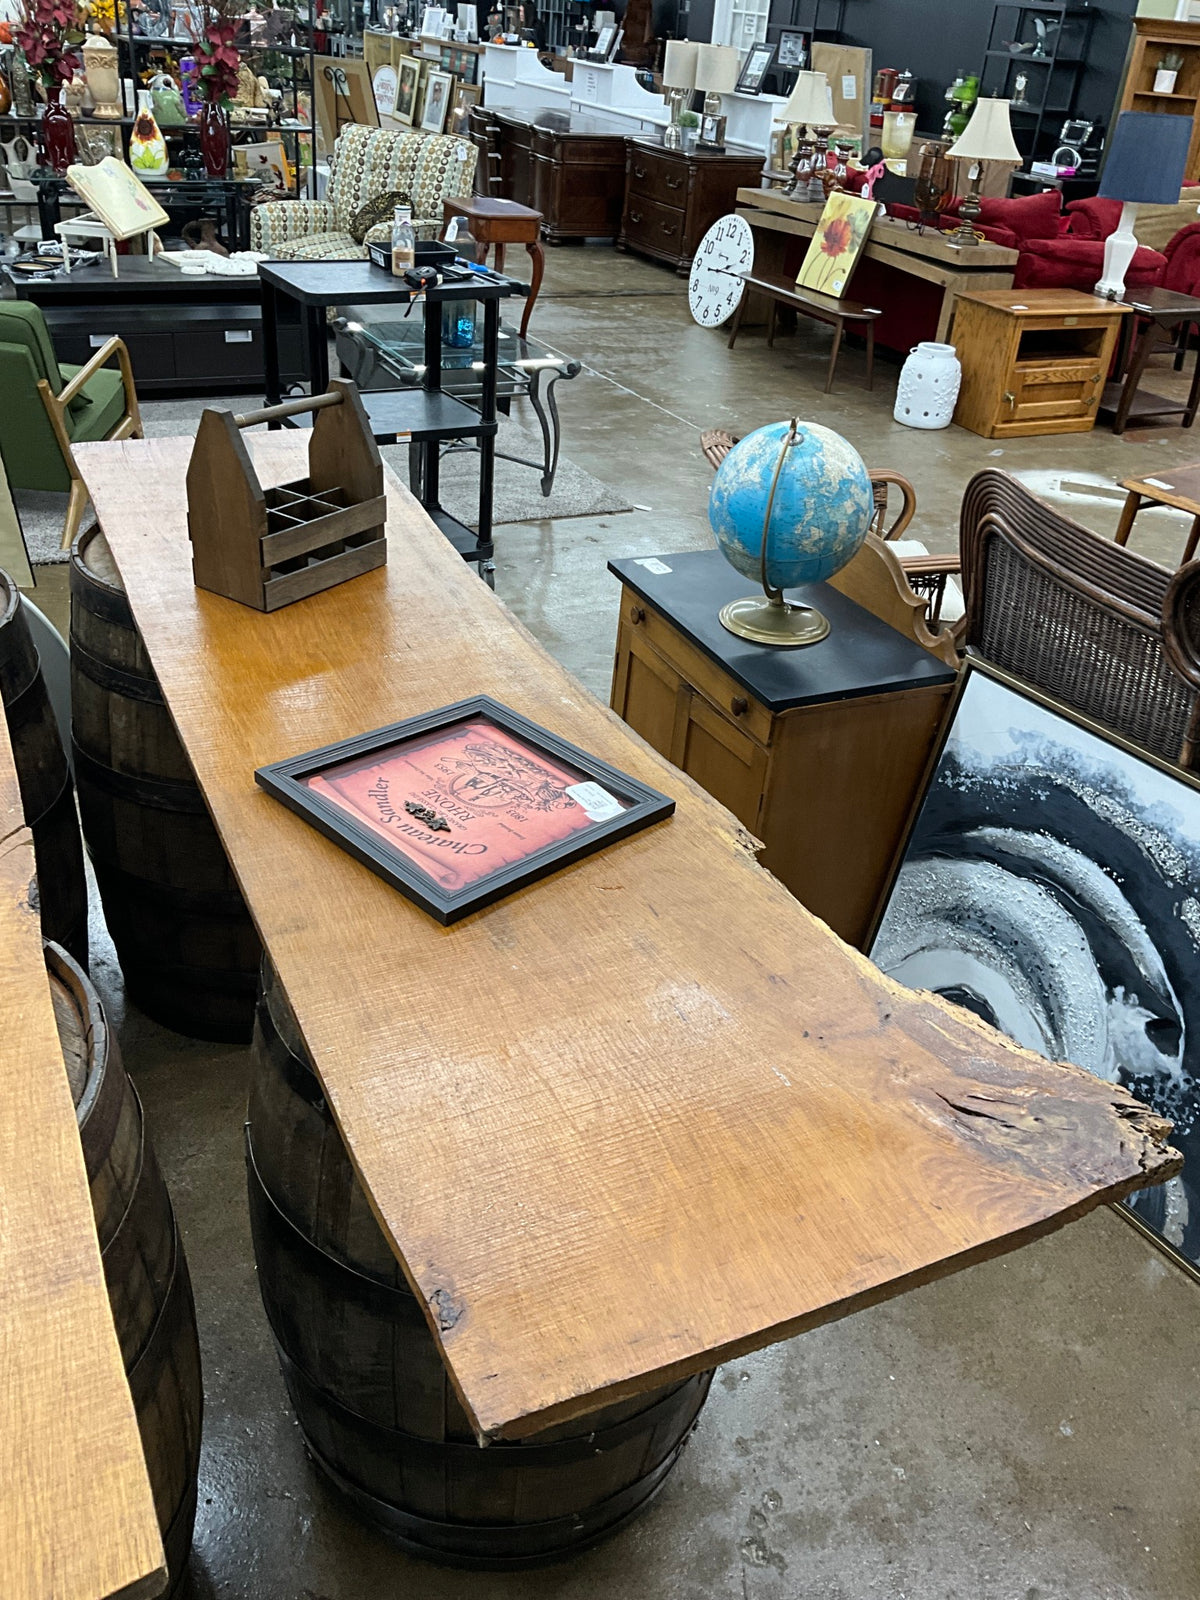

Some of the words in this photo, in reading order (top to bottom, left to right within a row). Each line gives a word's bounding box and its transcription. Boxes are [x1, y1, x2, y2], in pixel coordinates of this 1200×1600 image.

[716, 227, 724, 242] 11
[726, 223, 737, 238] 12
[737, 232, 743, 246] 1
[704, 240, 715, 255] 10
[696, 257, 703, 271] 9
[740, 250, 747, 264] 2
[692, 279, 699, 292] 8
[695, 296, 702, 309] 7
[726, 291, 734, 306] 4
[702, 305, 709, 319] 6
[714, 304, 722, 318] 5
[434, 763, 455, 776] 1953
[368, 777, 401, 824] Sandler
[421, 788, 476, 822] RHONE
[397, 823, 488, 856] Chateau
